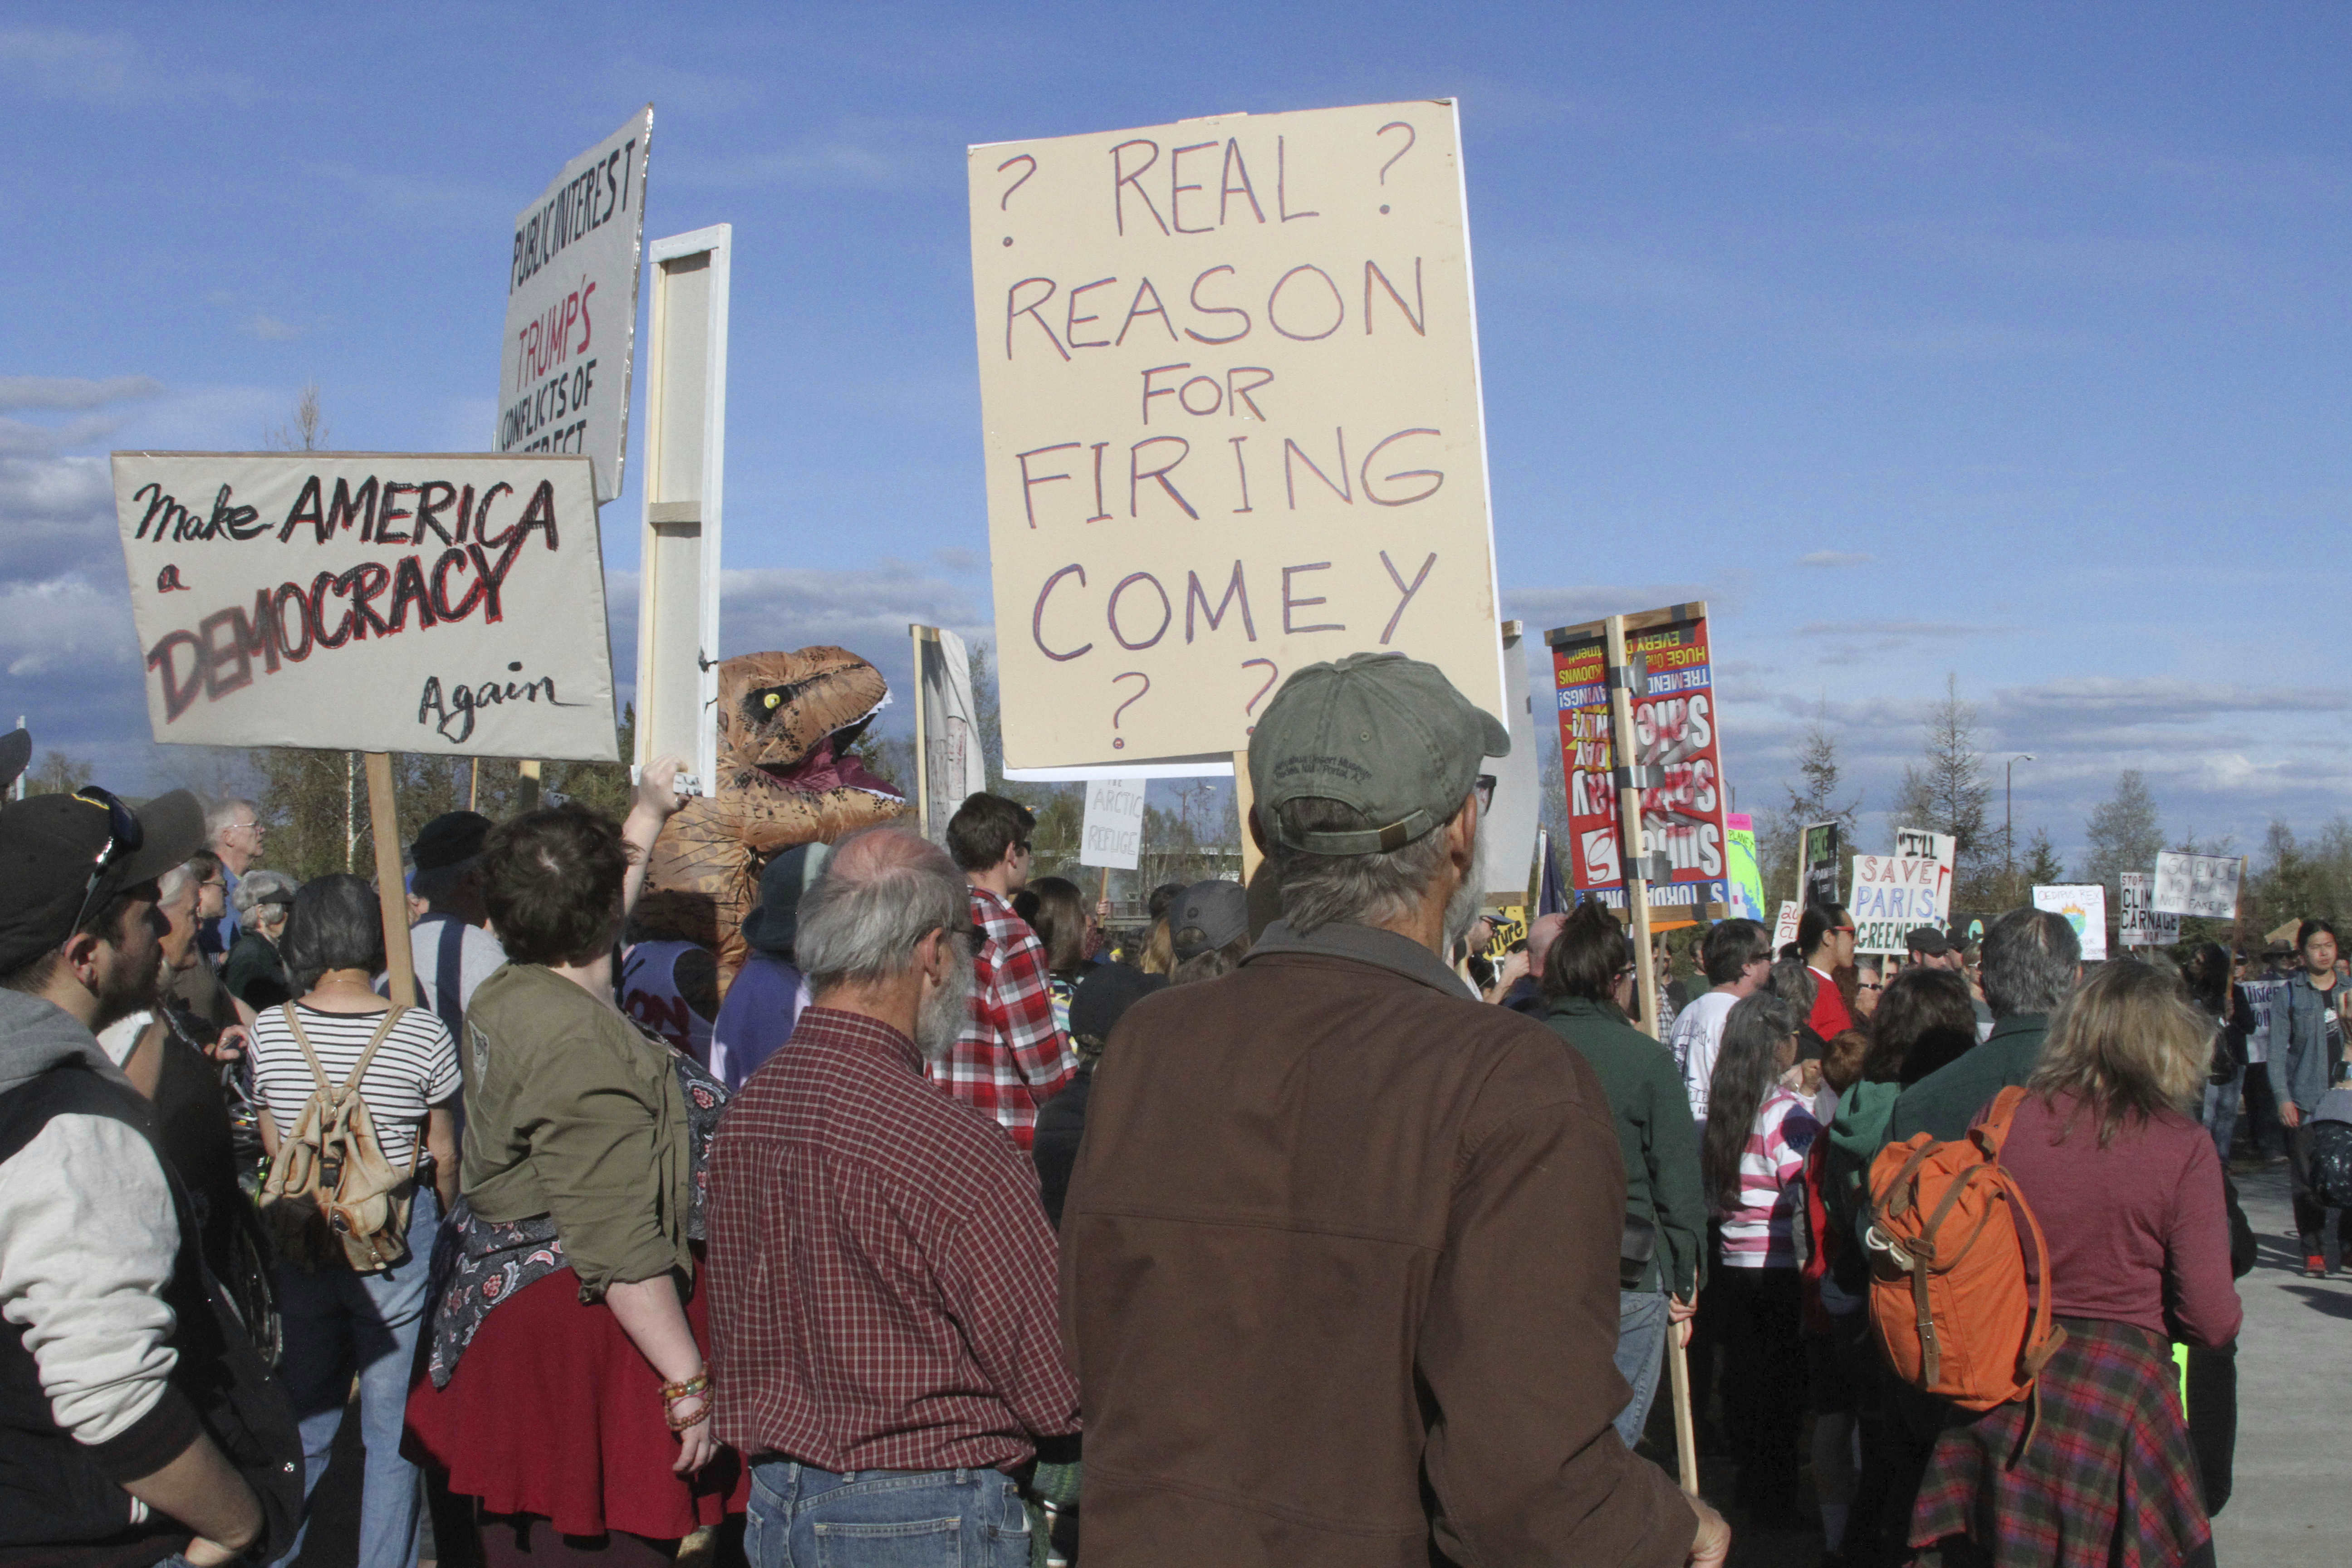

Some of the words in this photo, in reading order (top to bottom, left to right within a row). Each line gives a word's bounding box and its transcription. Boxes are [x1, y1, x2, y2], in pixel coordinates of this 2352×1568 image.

[998, 154, 1037, 247] ?
[1109, 135, 1320, 236] REAL
[1377, 121, 1416, 216] ?
[510, 194, 556, 296] PUBLIC
[551, 137, 636, 253] INTEREST
[1006, 256, 1426, 362] REASON
[517, 273, 596, 392] TRUMP'S
[502, 371, 568, 452] CONFLICTS
[573, 359, 597, 412] OF
[1141, 363, 1274, 425] FOR
[1015, 426, 1445, 529] FIRING
[133, 483, 274, 543] Make
[278, 475, 559, 551] AMERICA
[157, 563, 191, 593] a
[1033, 550, 1438, 662] COMEY
[147, 532, 529, 724] DEMOCRACY
[1637, 631, 1679, 652] EVERY
[1666, 646, 1706, 667] HUGE
[1559, 664, 1603, 685] KDOWNS
[419, 661, 596, 744] Again
[1112, 671, 1151, 750] ?
[1241, 658, 1278, 736] ?
[1559, 686, 1606, 708] AVINGS!
[1573, 713, 1608, 739] NLY!
[1636, 694, 1711, 752] Sale
[1574, 741, 1606, 767] DAY
[1093, 789, 1142, 818] ARCTIC
[1088, 825, 1137, 855] REFUGE
[1862, 856, 1934, 885] SAVE
[2122, 876, 2143, 886] STOP
[2167, 858, 2238, 881] SCIENCE
[1856, 886, 1934, 918] PARIS
[2123, 888, 2152, 908] CLIM
[2189, 898, 2215, 910] FAKE
[2122, 910, 2176, 930] CARNAGE
